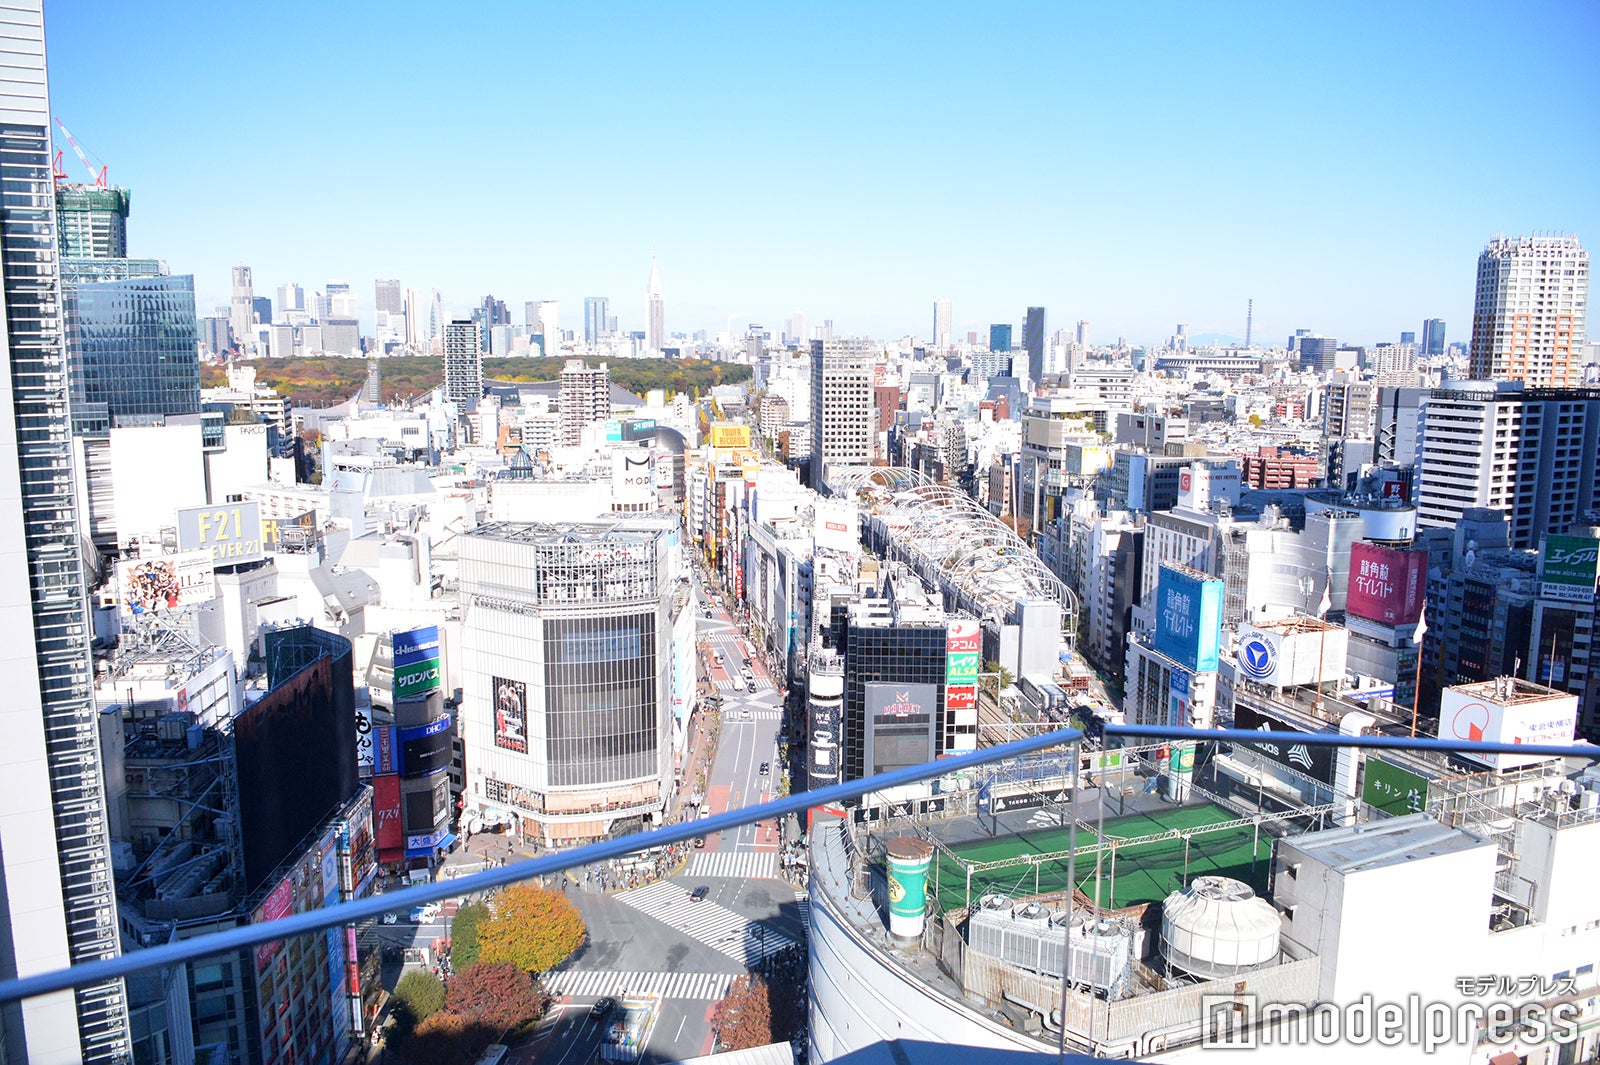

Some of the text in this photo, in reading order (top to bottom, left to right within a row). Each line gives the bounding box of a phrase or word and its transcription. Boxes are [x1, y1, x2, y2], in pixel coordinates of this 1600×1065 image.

[240, 426, 265, 434] PARCO
[722, 428, 741, 436] TOWER
[719, 437, 746, 445] RECORDS
[199, 509, 242, 543] F21
[245, 539, 260, 555] 21
[1548, 548, 1598, 565] エイブル
[950, 640, 978, 650] アコム
[949, 656, 977, 667] レイク
[949, 667, 977, 676] ALSA
[398, 667, 440, 688] サロンパス
[948, 692, 974, 701] アイフル
[426, 723, 441, 734] DHC
